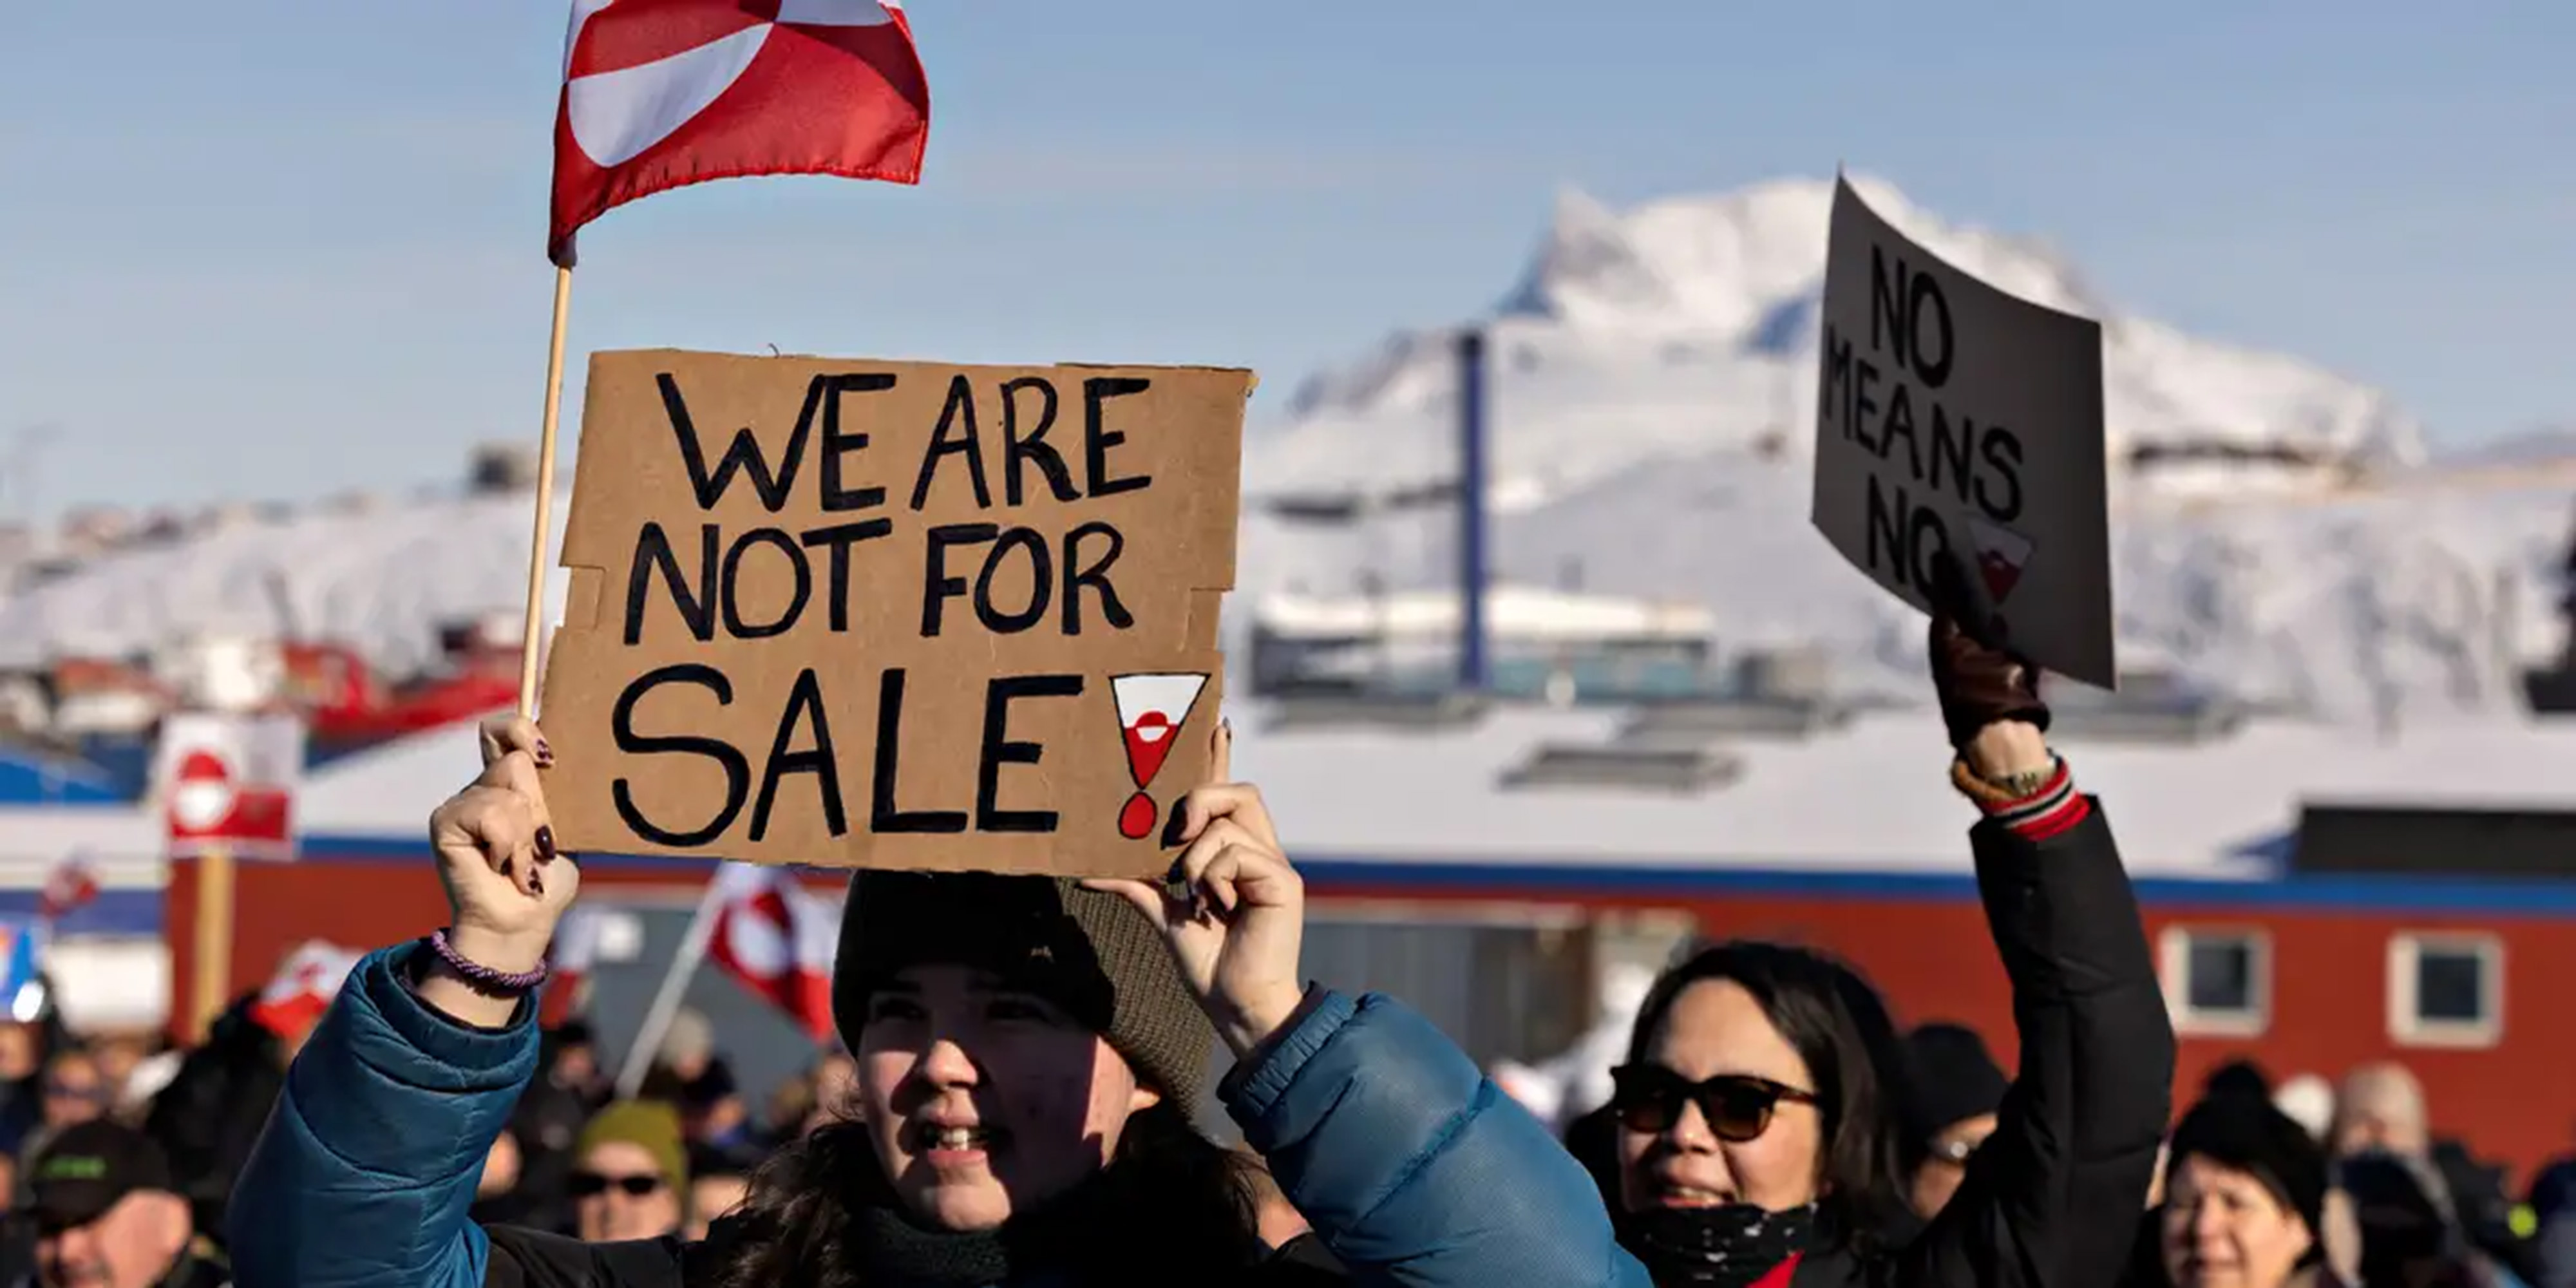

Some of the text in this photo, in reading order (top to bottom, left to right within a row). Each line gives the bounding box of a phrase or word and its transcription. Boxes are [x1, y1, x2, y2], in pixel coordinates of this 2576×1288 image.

[1871, 244, 1955, 389] NO
[656, 373, 1152, 513] WE ARE
[1824, 325, 2024, 527] MEANS
[623, 517, 1134, 645] NOT FOR
